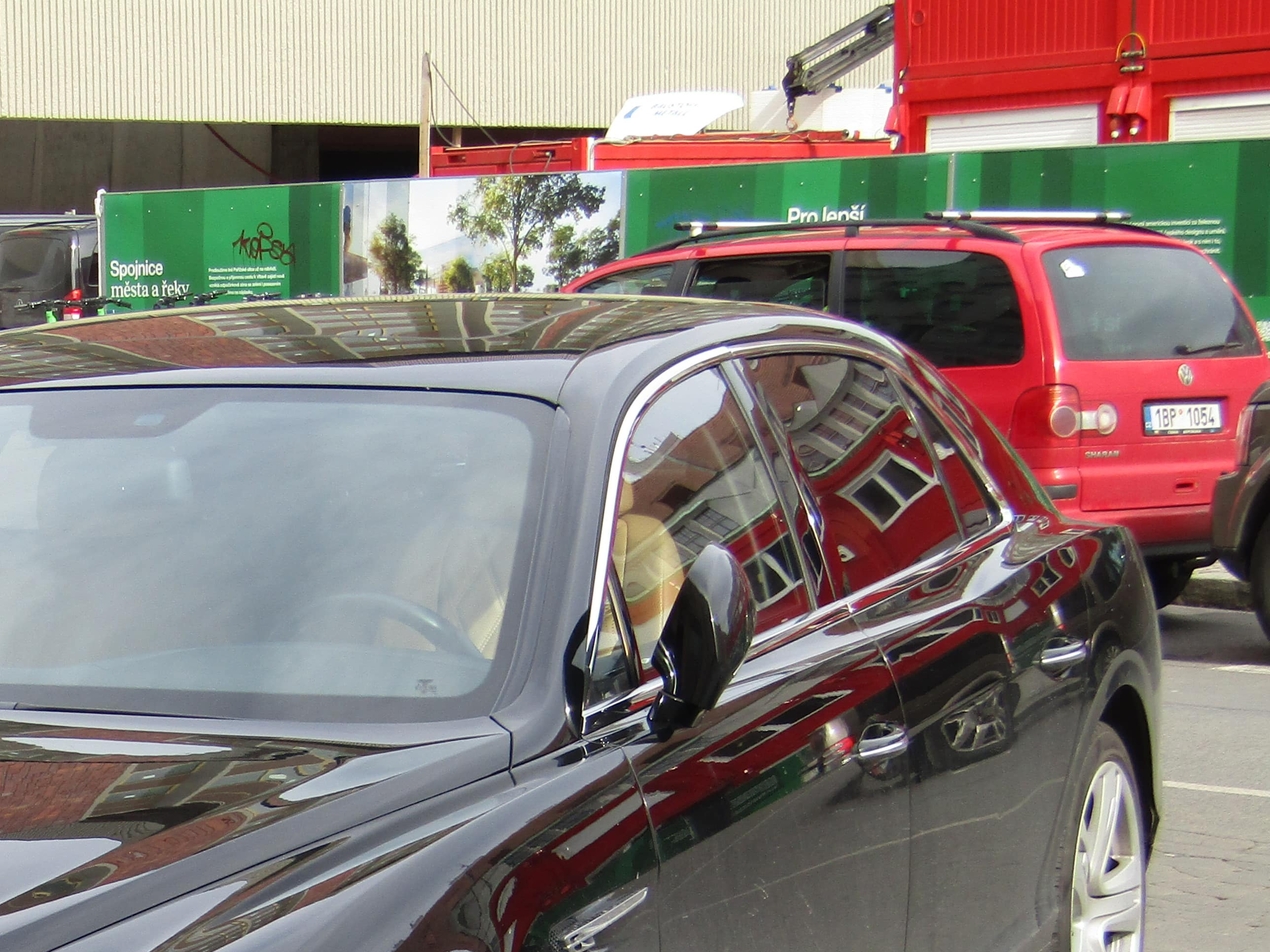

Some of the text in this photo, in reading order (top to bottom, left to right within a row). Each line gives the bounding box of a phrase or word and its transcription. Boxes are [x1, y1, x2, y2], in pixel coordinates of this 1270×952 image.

[787, 207, 818, 223] Pro
[110, 260, 163, 280] Spojnice
[111, 281, 149, 298] města
[151, 284, 158, 296] a
[1155, 407, 1176, 428] 1BP
[1187, 407, 1215, 426] 1054
[1085, 450, 1120, 458] SHARAN
